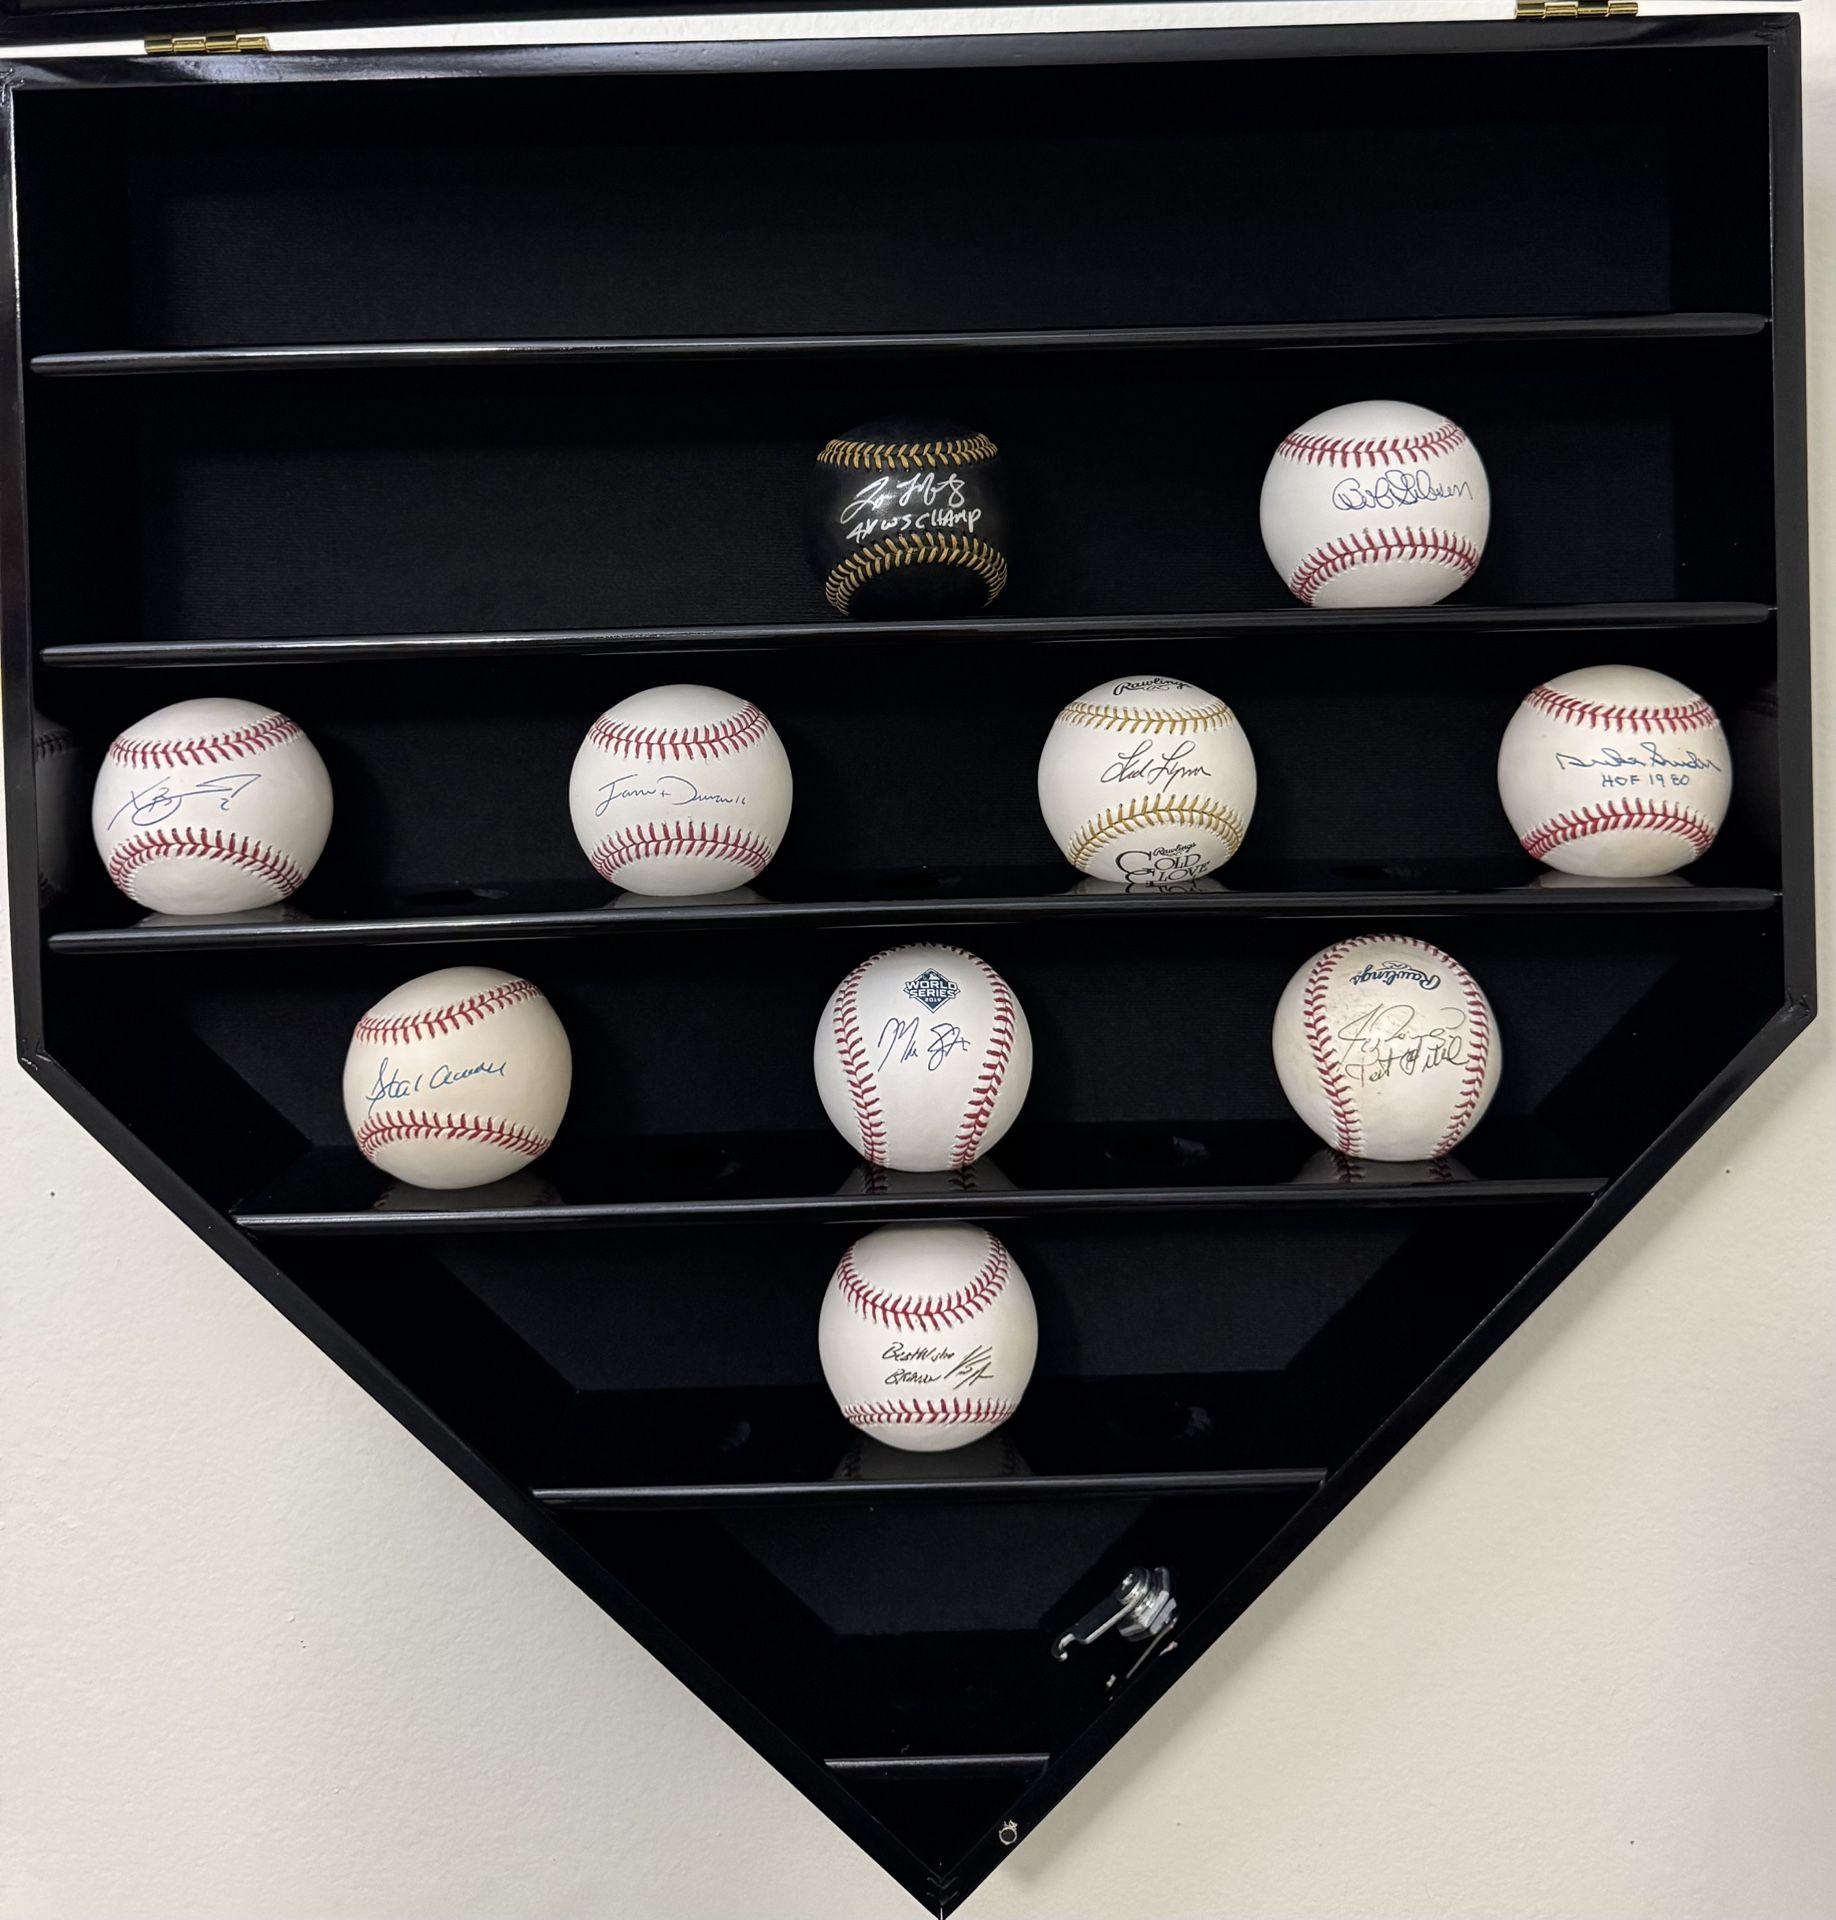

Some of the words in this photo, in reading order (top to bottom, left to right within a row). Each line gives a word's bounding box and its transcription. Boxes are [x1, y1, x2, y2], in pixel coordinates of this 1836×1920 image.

[914, 507, 982, 533] CHAMP
[1601, 774, 1640, 788] HOF
[1153, 842, 1197, 856] Rawlings
[1115, 850, 1201, 876] GOLD
[1349, 963, 1442, 990] Rawlings
[906, 980, 958, 990] WORLD
[909, 988, 956, 999] SERIES
